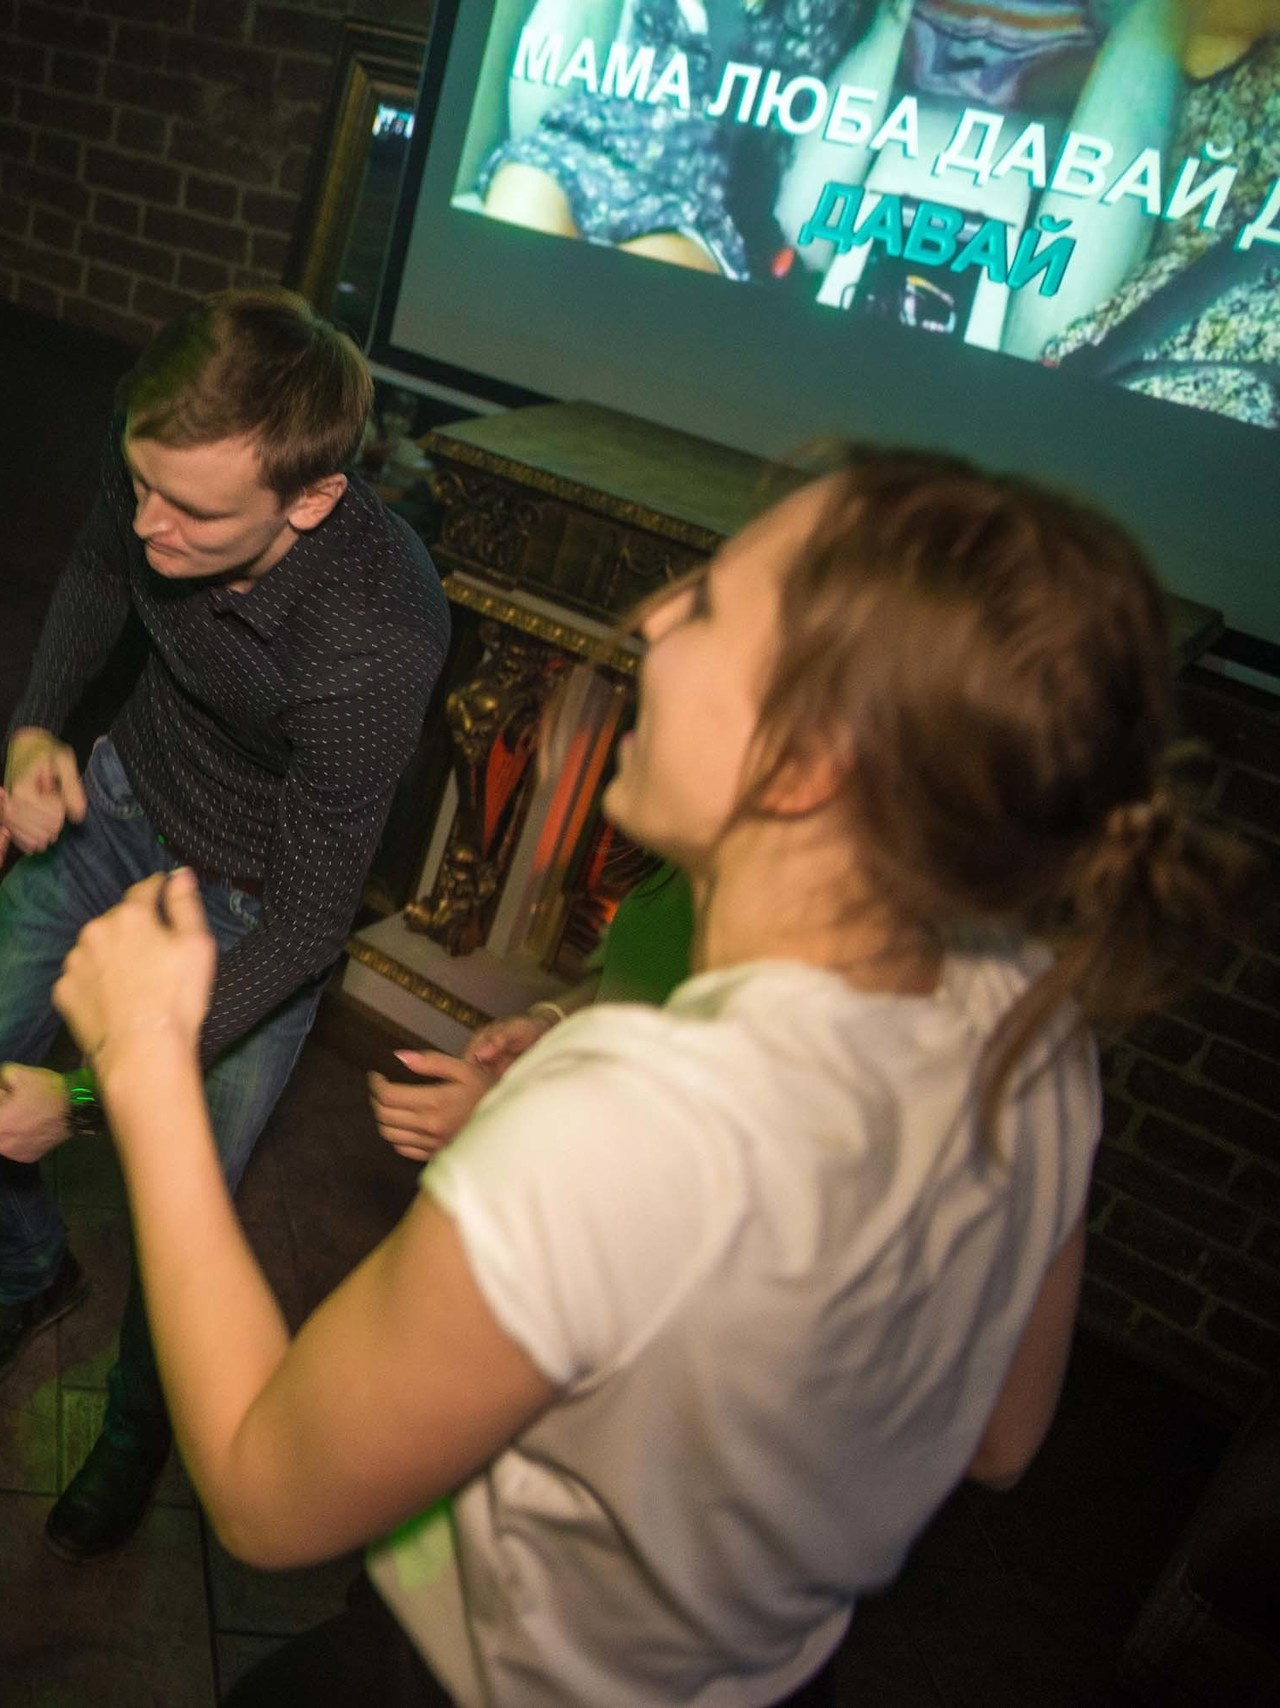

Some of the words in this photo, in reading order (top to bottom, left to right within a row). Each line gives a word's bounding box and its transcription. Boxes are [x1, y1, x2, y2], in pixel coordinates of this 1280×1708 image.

[512, 25, 692, 111] МАМА
[705, 60, 920, 158] ЛЮБА
[931, 107, 1239, 231] ДАВАЙ
[797, 181, 1077, 297] ДАВАЙ
